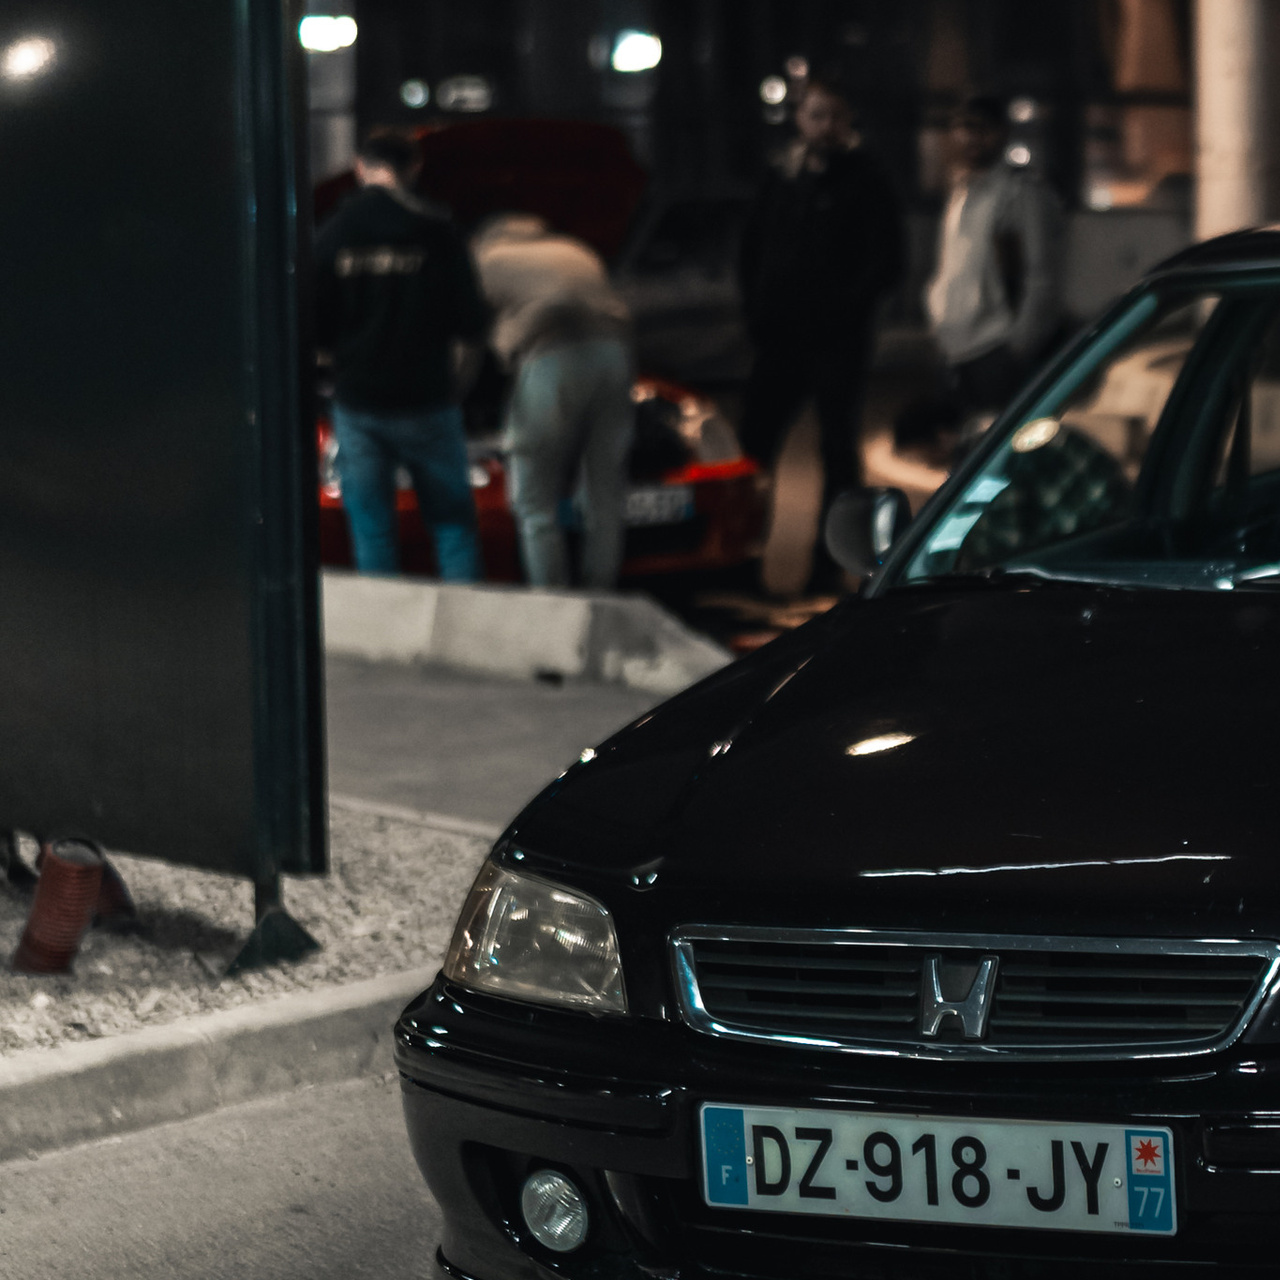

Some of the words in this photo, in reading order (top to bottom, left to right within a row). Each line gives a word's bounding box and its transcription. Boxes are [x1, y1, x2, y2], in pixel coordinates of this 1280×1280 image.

[721, 1165, 733, 1186] F
[751, 1124, 1110, 1216] DZ-918-JY
[1133, 1186, 1165, 1218] 77
